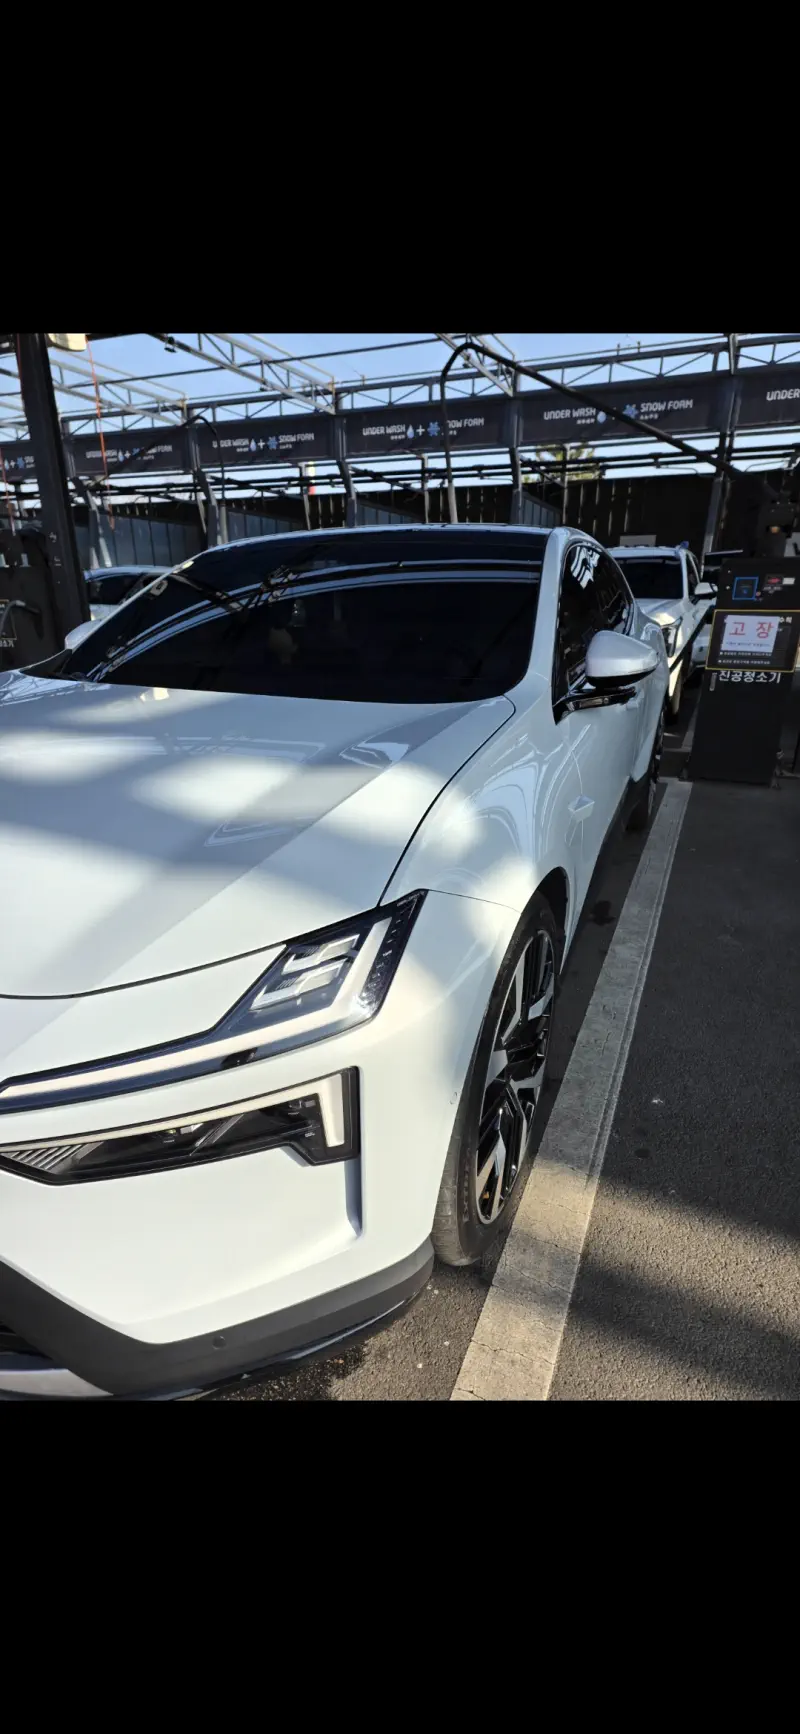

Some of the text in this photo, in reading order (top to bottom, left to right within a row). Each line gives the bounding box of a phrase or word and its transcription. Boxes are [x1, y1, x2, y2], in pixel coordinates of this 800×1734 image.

[766, 389, 800, 401] UNDER
[543, 399, 694, 420] UNDER WASH SNOW FOAM
[362, 426, 385, 436] UNDER
[386, 424, 406, 434] WASH
[463, 418, 485, 427] FOAM
[212, 439, 232, 448] UDER
[729, 622, 774, 639] 고 장
[719, 670, 781, 684] 진공청소기
